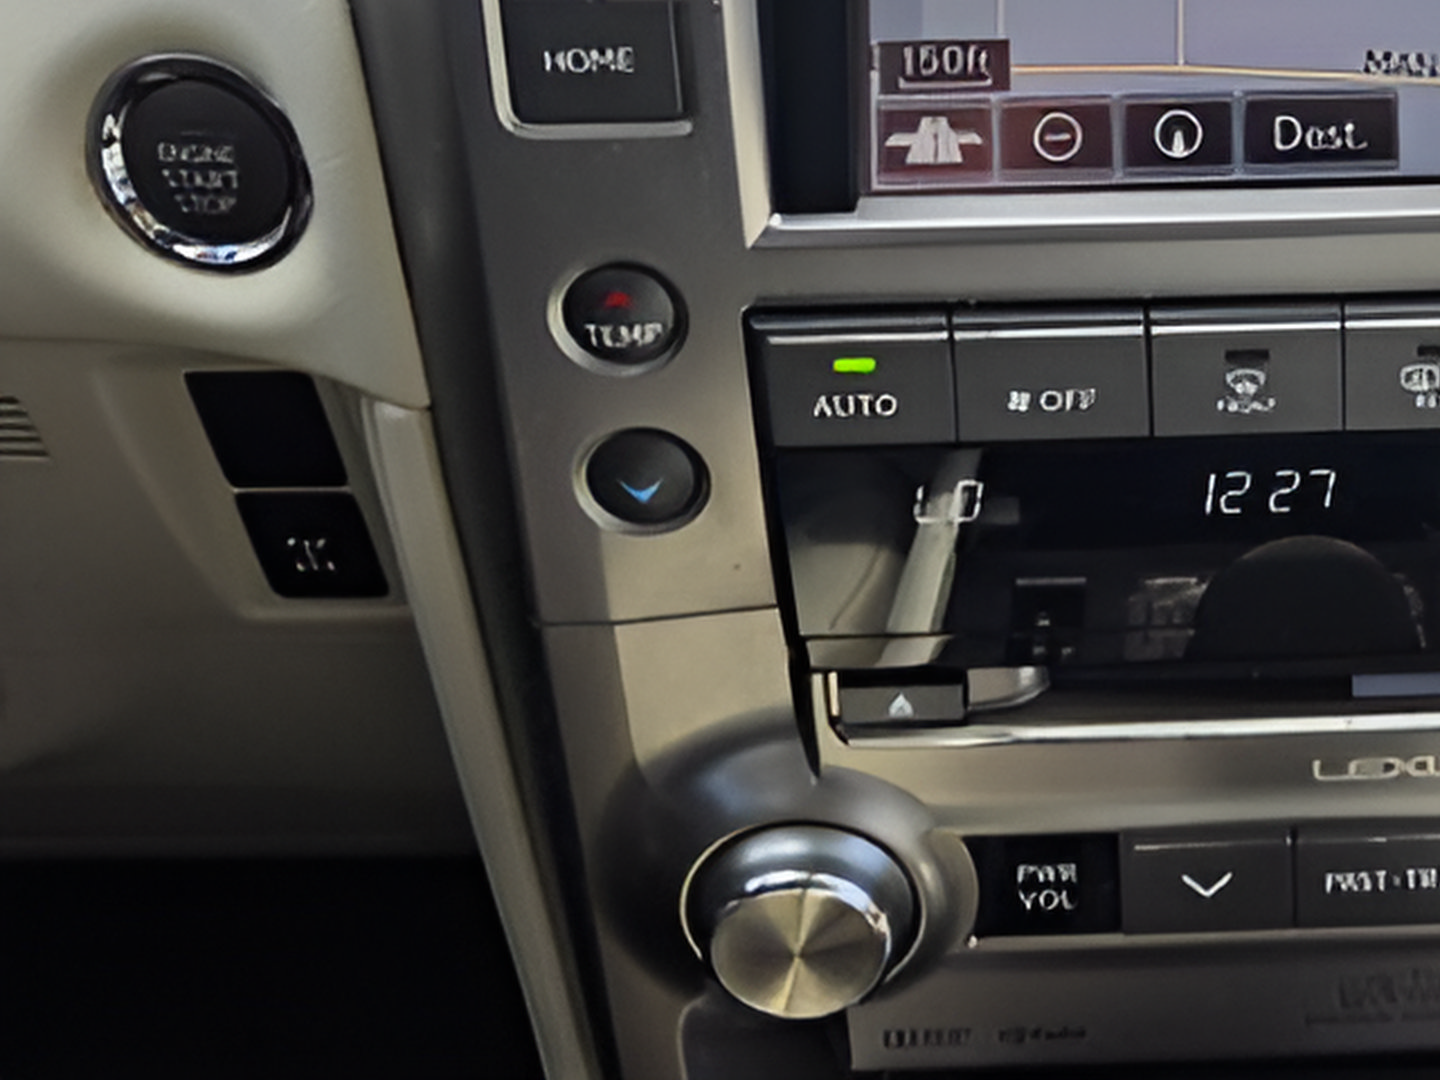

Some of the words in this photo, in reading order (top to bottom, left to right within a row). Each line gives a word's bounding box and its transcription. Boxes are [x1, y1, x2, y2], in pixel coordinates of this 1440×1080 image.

[543, 46, 635, 75] HOME
[813, 394, 898, 418] AUTO
[1039, 388, 1096, 412] OFF
